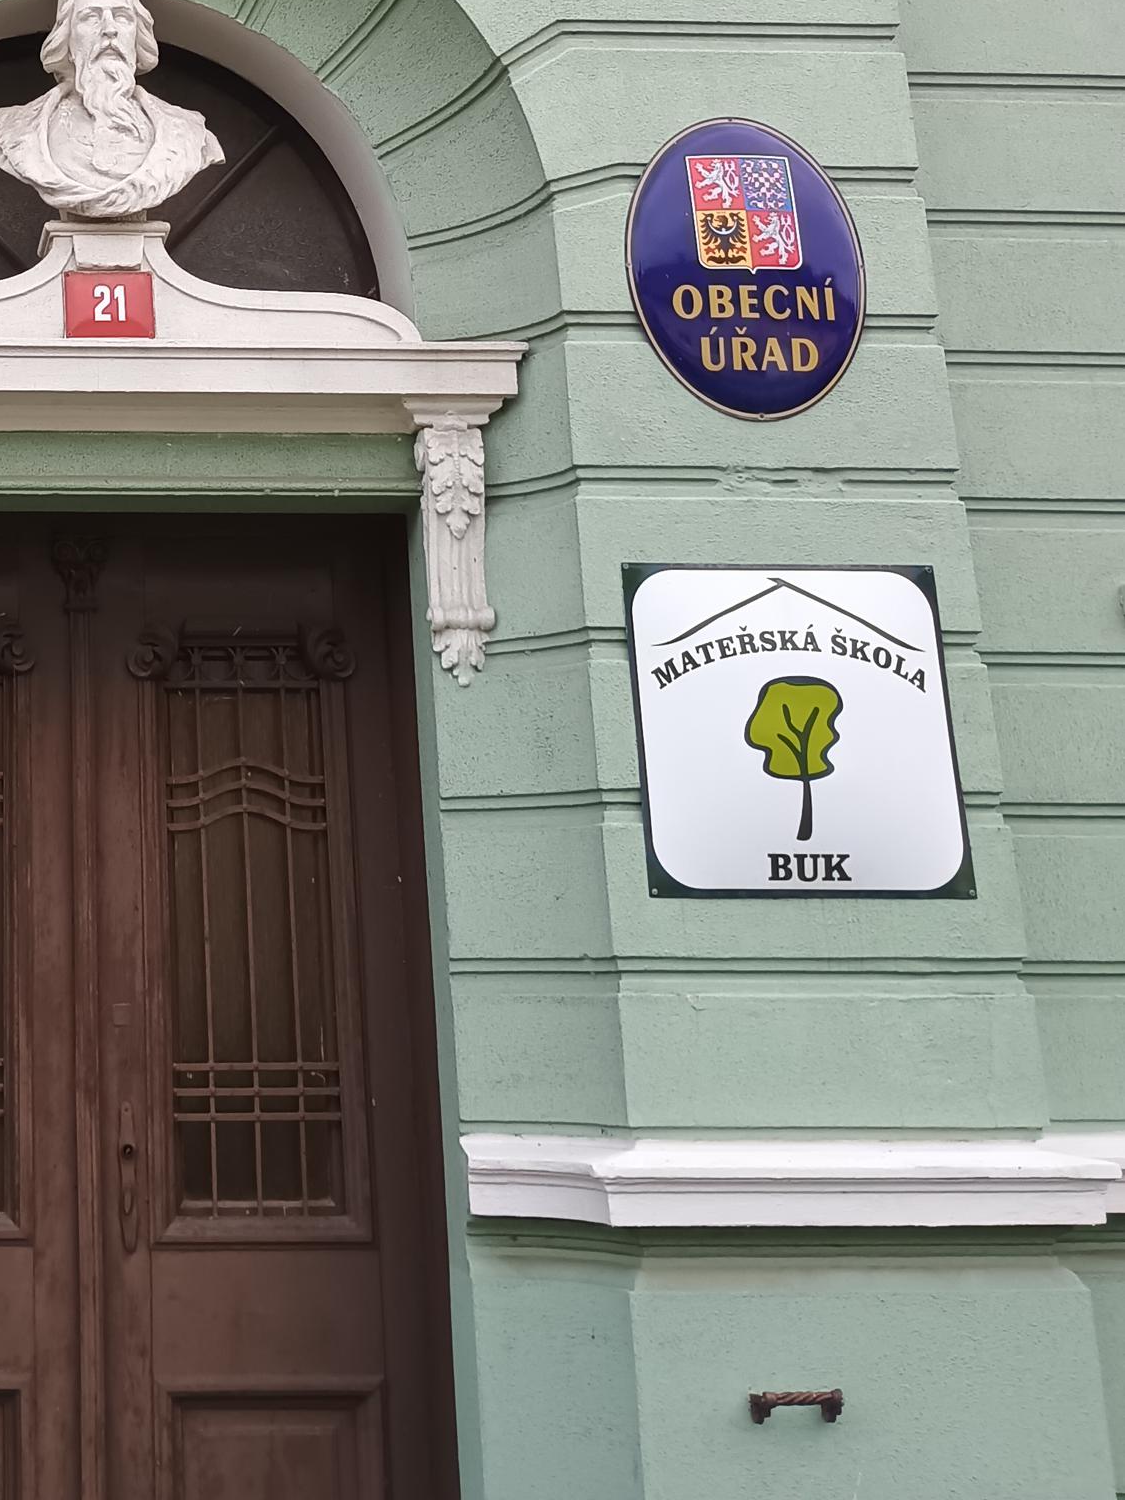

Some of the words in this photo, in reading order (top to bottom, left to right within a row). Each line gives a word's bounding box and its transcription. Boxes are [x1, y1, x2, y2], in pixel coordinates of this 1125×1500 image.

[93, 284, 126, 322] 21
[672, 278, 836, 321] OBECNÍ
[700, 326, 819, 372] ÚŘAD
[651, 624, 822, 689] MATEŘSKÁ
[830, 627, 927, 693] ŠKOLA
[767, 853, 852, 882] BUK
